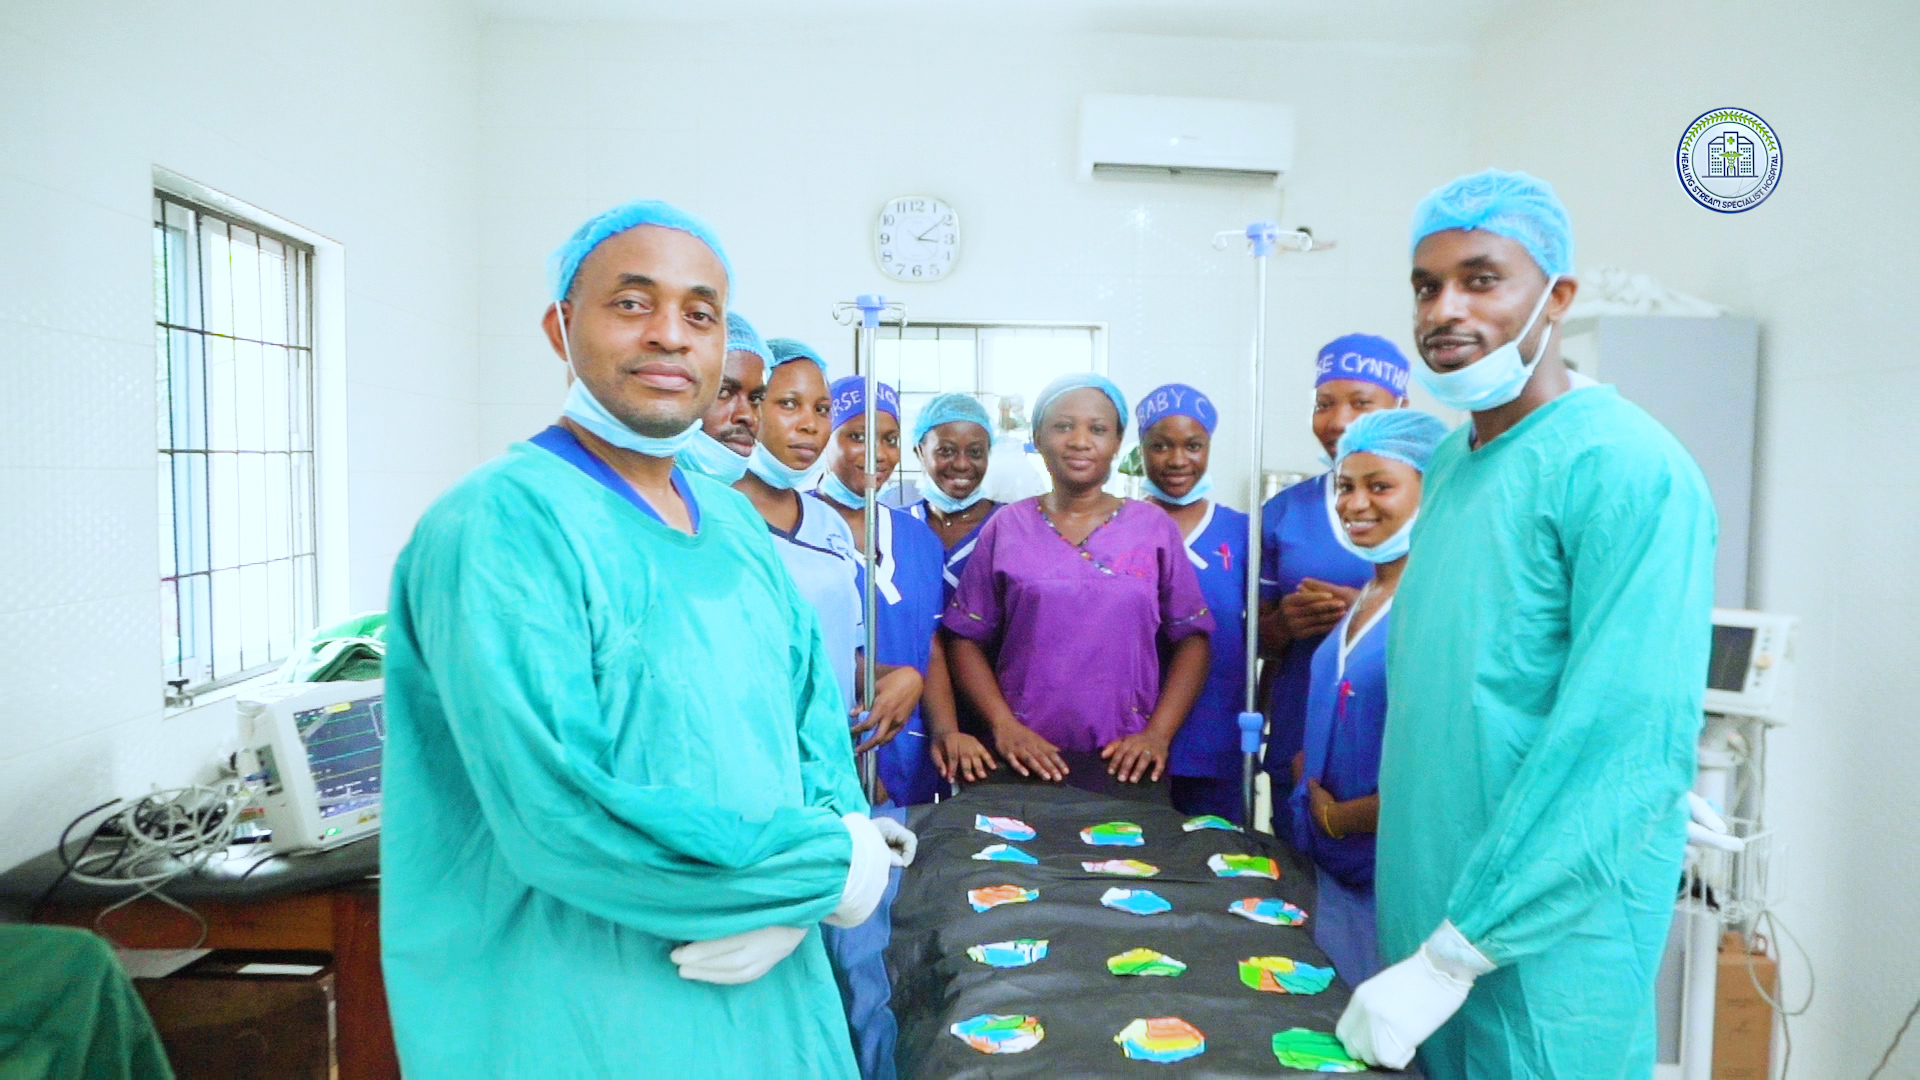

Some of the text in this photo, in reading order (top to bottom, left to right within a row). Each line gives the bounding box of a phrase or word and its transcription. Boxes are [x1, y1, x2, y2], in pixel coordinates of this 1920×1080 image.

[897, 202, 906, 213] 11
[910, 200, 925, 213] 12
[883, 214, 895, 226] 10
[942, 213, 953, 227] 2
[880, 233, 890, 245] 9
[944, 233, 955, 245] 3
[882, 250, 893, 263] 8
[895, 262, 906, 275] 7
[912, 264, 922, 277] 6
[929, 263, 940, 276] 5
[1137, 387, 1187, 427] BABY
